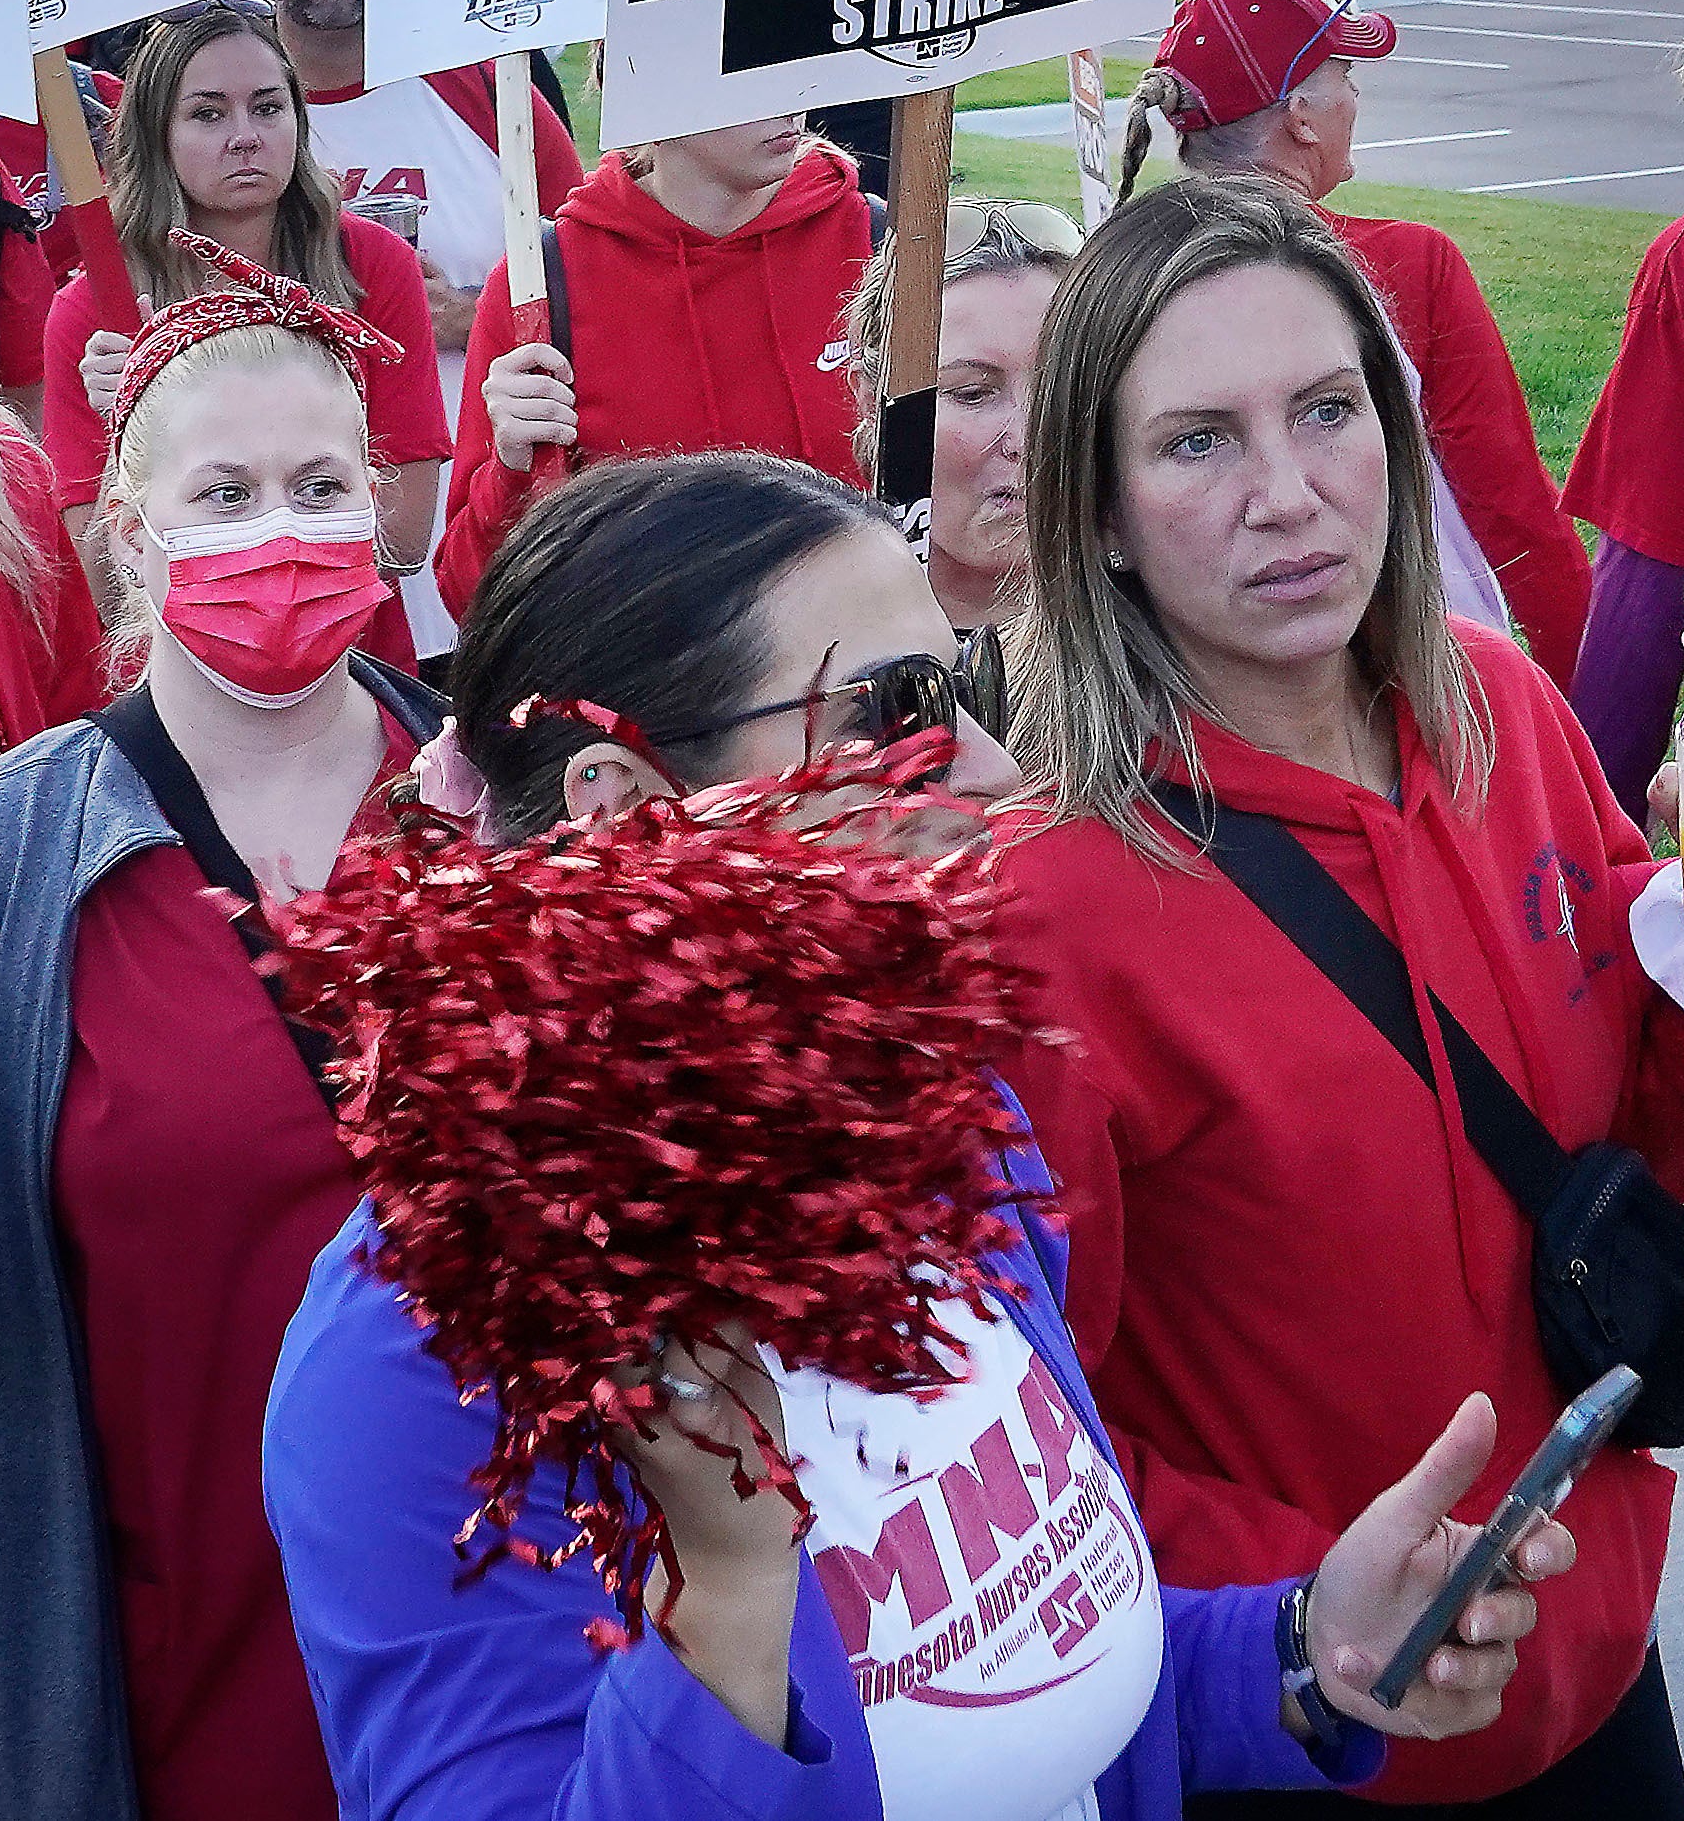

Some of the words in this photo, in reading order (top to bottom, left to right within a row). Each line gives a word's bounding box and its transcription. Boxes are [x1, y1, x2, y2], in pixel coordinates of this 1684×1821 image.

[814, 1351, 1078, 1657] MNA
[1080, 1520, 1120, 1578] National
[1090, 1549, 1125, 1595] Nurses
[975, 1543, 1052, 1640] Nurses
[1100, 1564, 1134, 1612] United
[979, 1659, 997, 1683] An
[993, 1625, 1031, 1668] Affiliate
[1029, 1611, 1040, 1634] of
